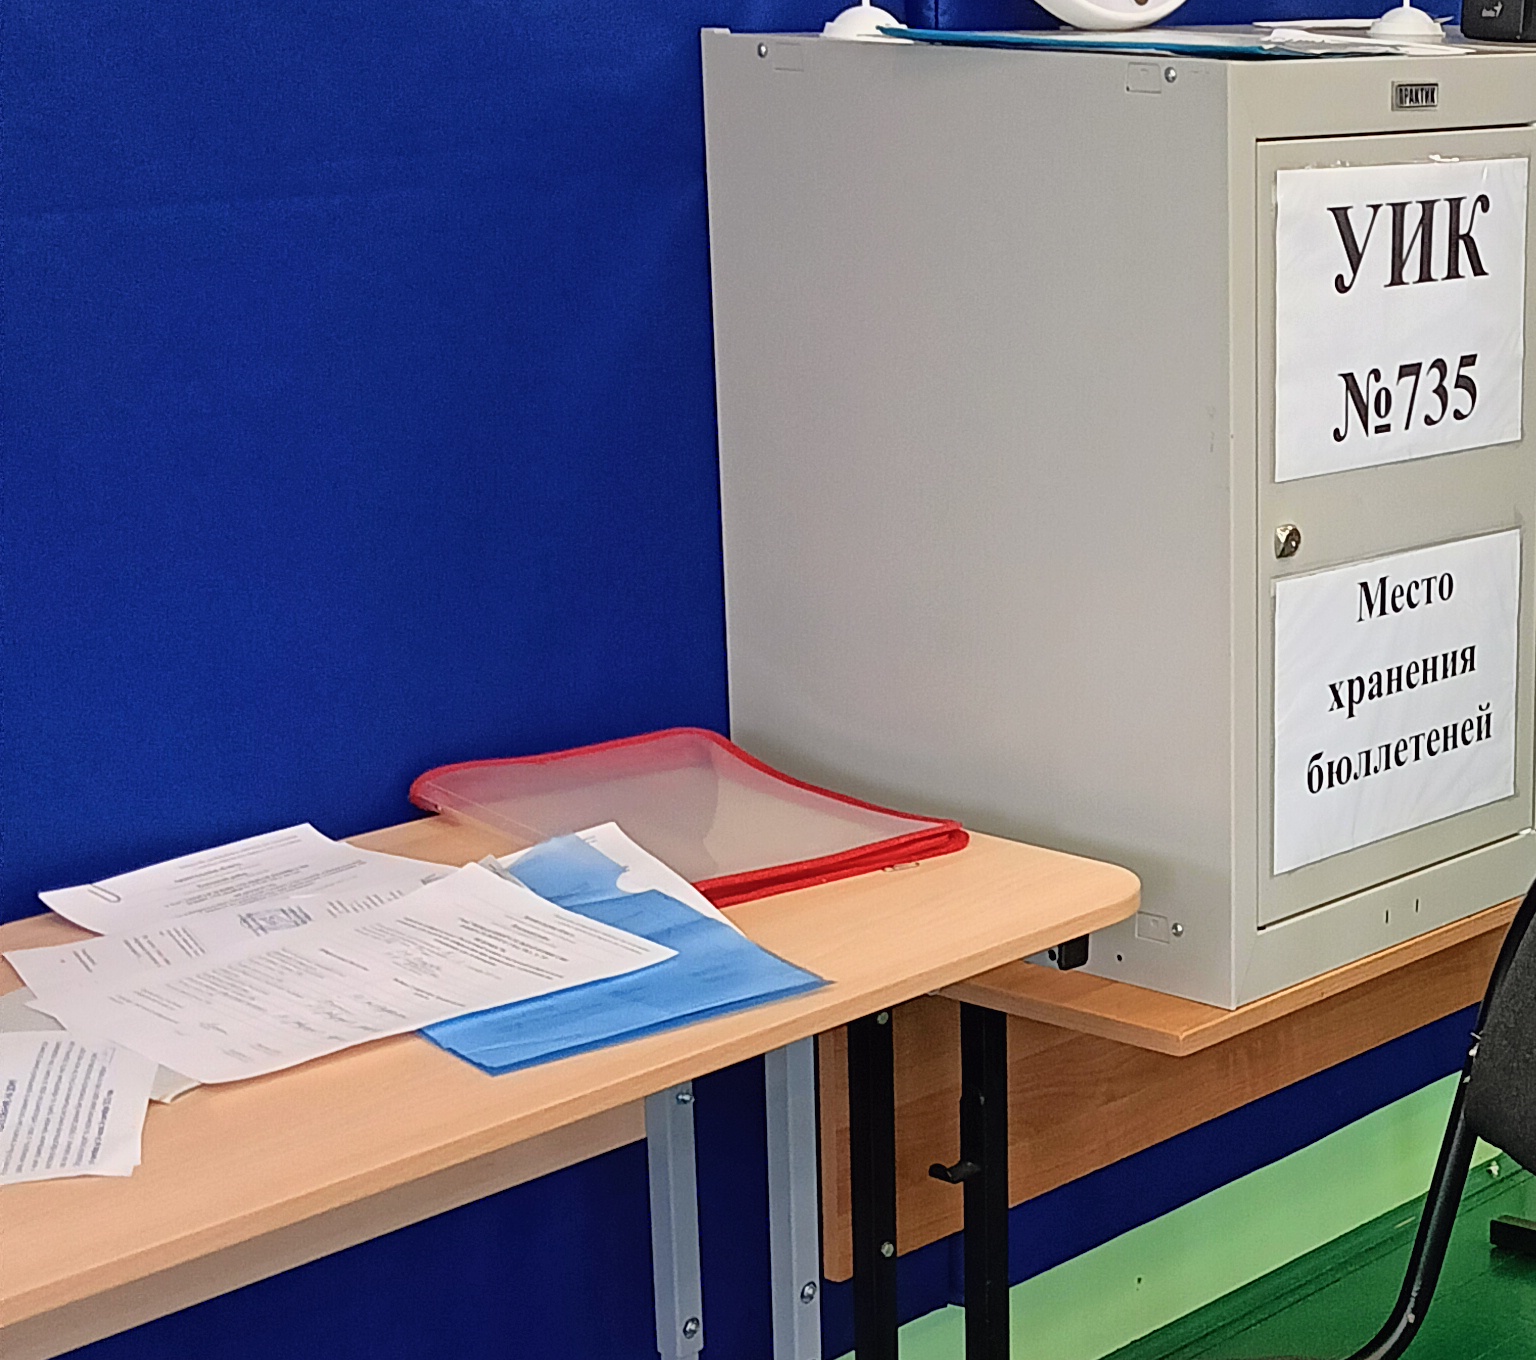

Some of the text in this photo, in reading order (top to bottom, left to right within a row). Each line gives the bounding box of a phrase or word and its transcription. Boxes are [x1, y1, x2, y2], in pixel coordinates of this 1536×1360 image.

[1399, 87, 1435, 105] ПРАКТИК
[1327, 194, 1490, 294] УИК
[1333, 353, 1478, 442] №735
[1356, 572, 1454, 623] Место
[1328, 645, 1476, 720] хранения
[1306, 702, 1493, 794] бюллетеней
